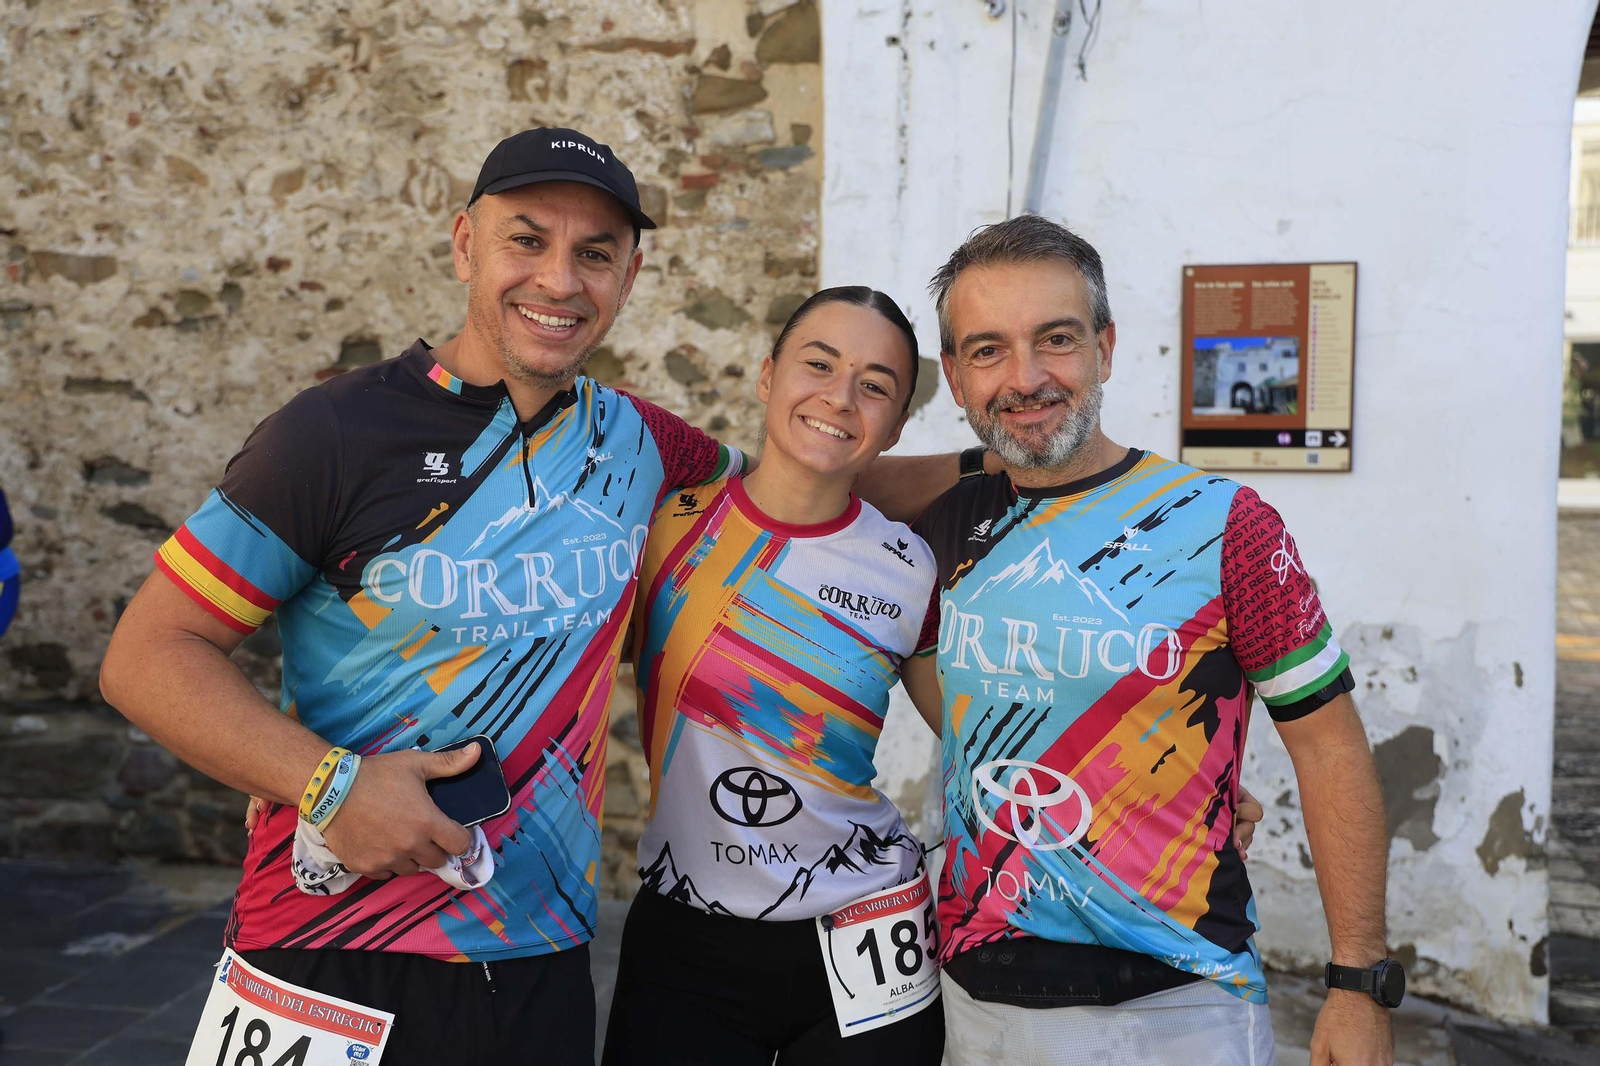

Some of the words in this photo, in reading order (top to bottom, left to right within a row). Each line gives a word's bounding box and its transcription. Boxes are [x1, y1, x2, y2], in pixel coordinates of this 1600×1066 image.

[551, 140, 606, 164] KIPRUN
[583, 532, 607, 542] 2023
[1103, 541, 1152, 551] SPALL
[881, 541, 915, 567] SPALL
[367, 524, 649, 619] CORRUCO
[819, 586, 902, 619] CORRUCO
[452, 620, 534, 643] TRAIL
[543, 608, 612, 633] TEAM
[849, 611, 870, 621] TEAM
[1072, 615, 1103, 625] 2023
[938, 599, 1183, 681] ORRUCO
[980, 679, 1054, 704] TEAM
[710, 841, 799, 866] TOMAX
[854, 894, 909, 915] CARRERA
[856, 902, 939, 985] 185
[890, 981, 915, 998] ALBA
[240, 973, 279, 1004] CARRERA
[281, 995, 306, 1015] DEL
[308, 1002, 382, 1035] ESTRECHO
